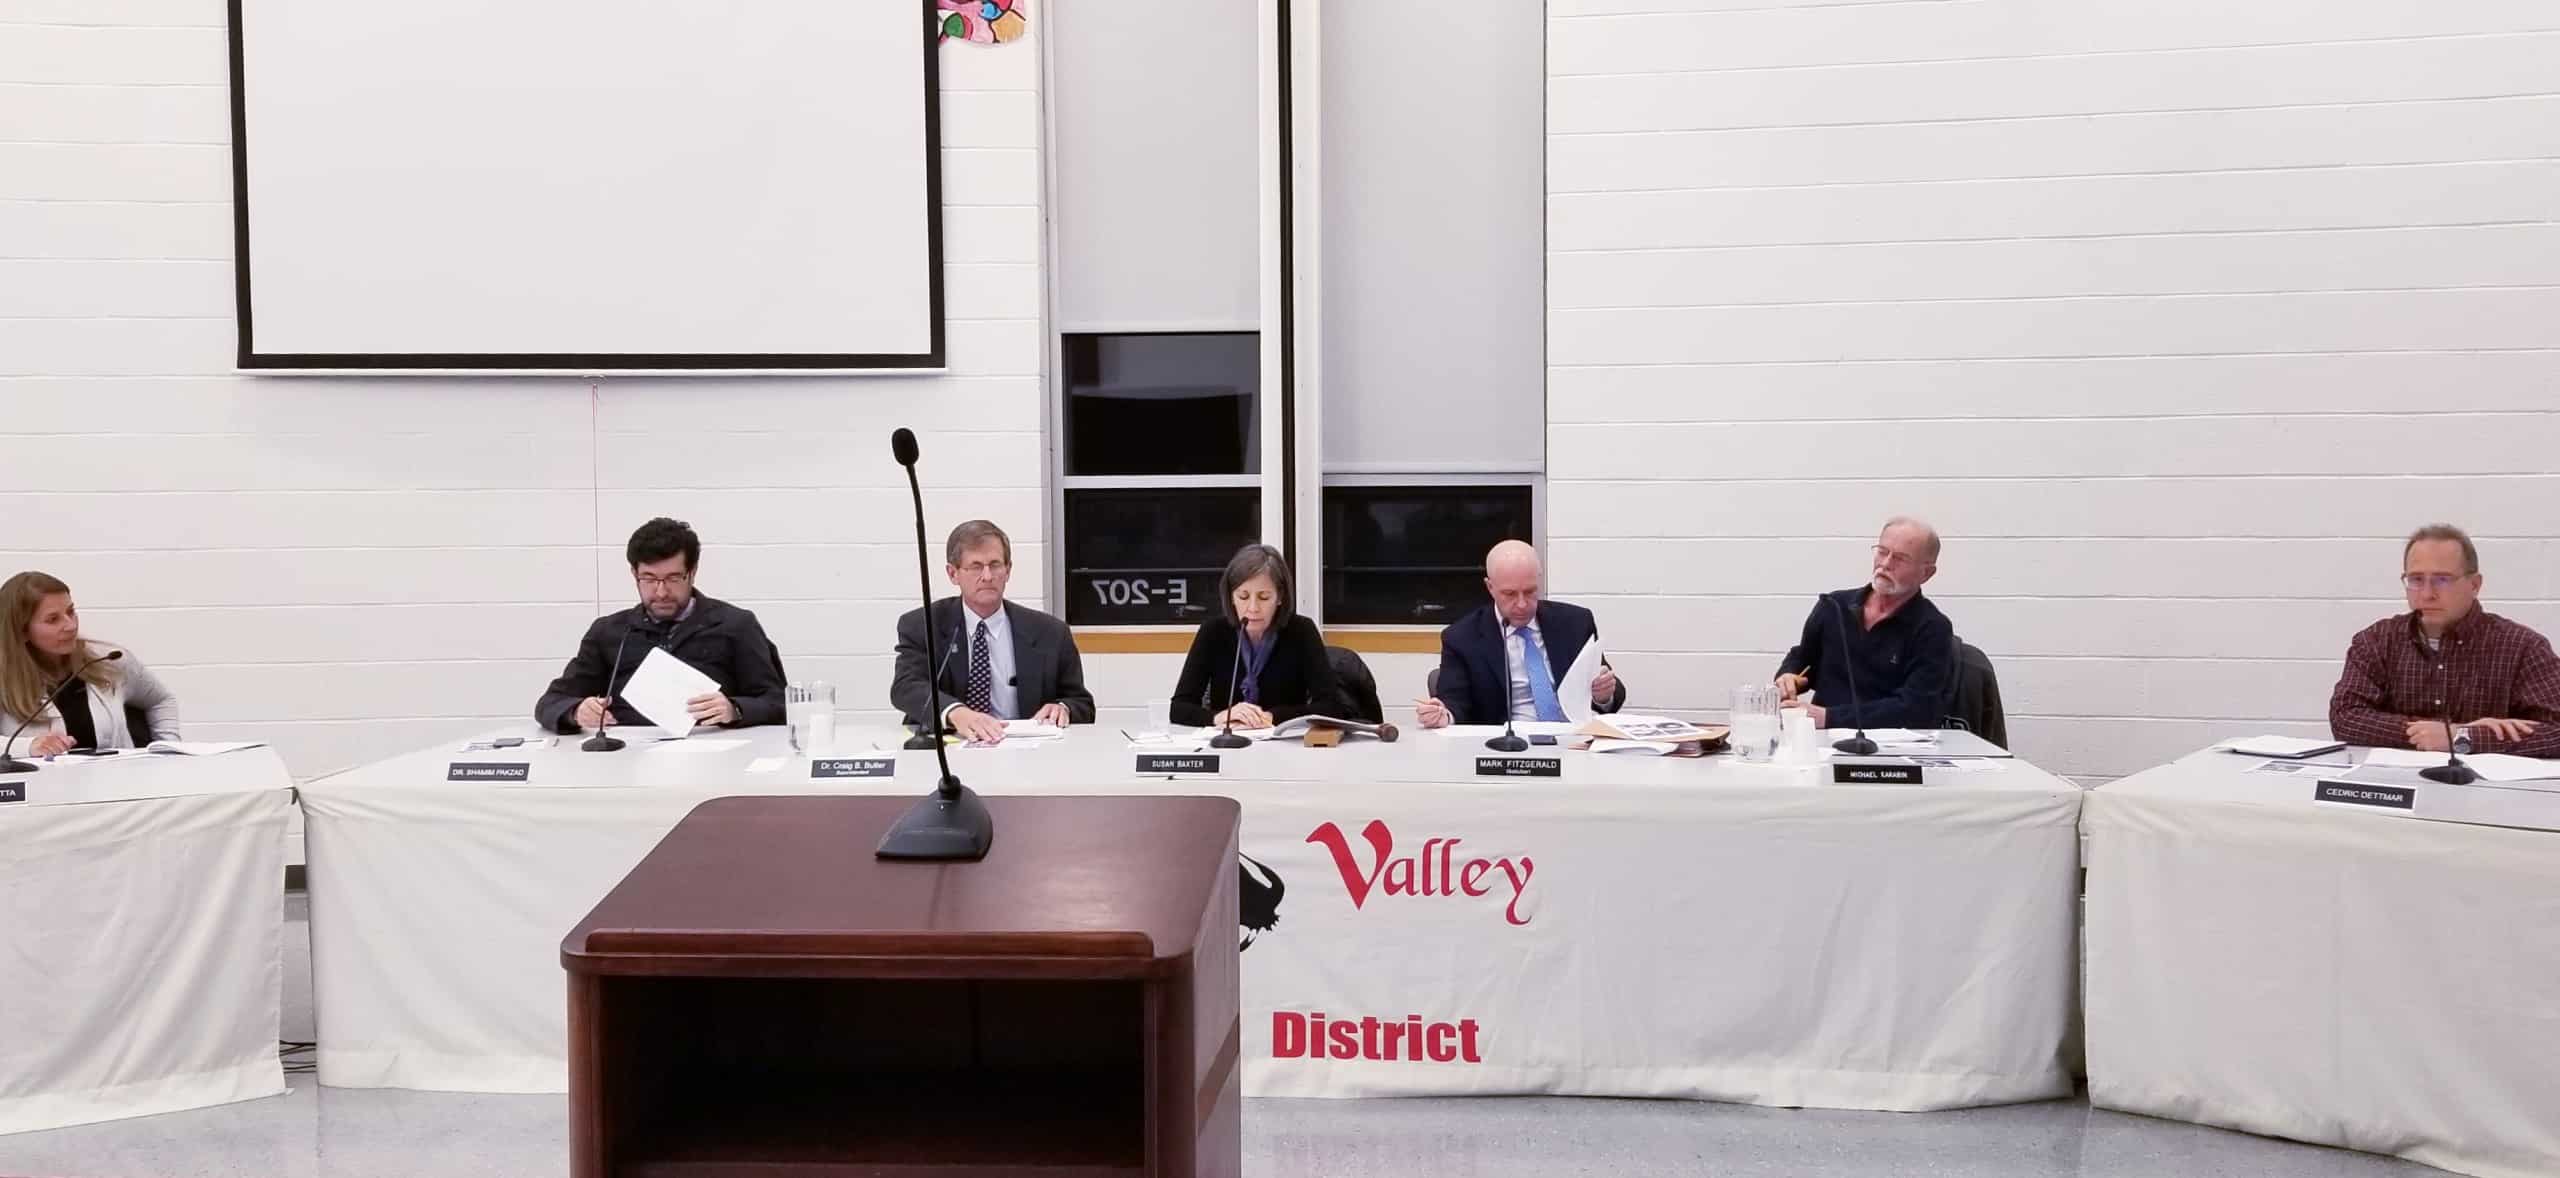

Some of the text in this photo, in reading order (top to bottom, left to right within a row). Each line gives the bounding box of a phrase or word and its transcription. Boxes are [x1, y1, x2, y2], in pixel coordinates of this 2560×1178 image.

[1151, 760, 1175, 768] SUSAN
[1479, 759, 1557, 769] MARK FITZGERALD
[2326, 787, 2360, 798] CEDRIC
[1305, 819, 1534, 926] Valley
[1272, 1011, 1481, 1063] District
